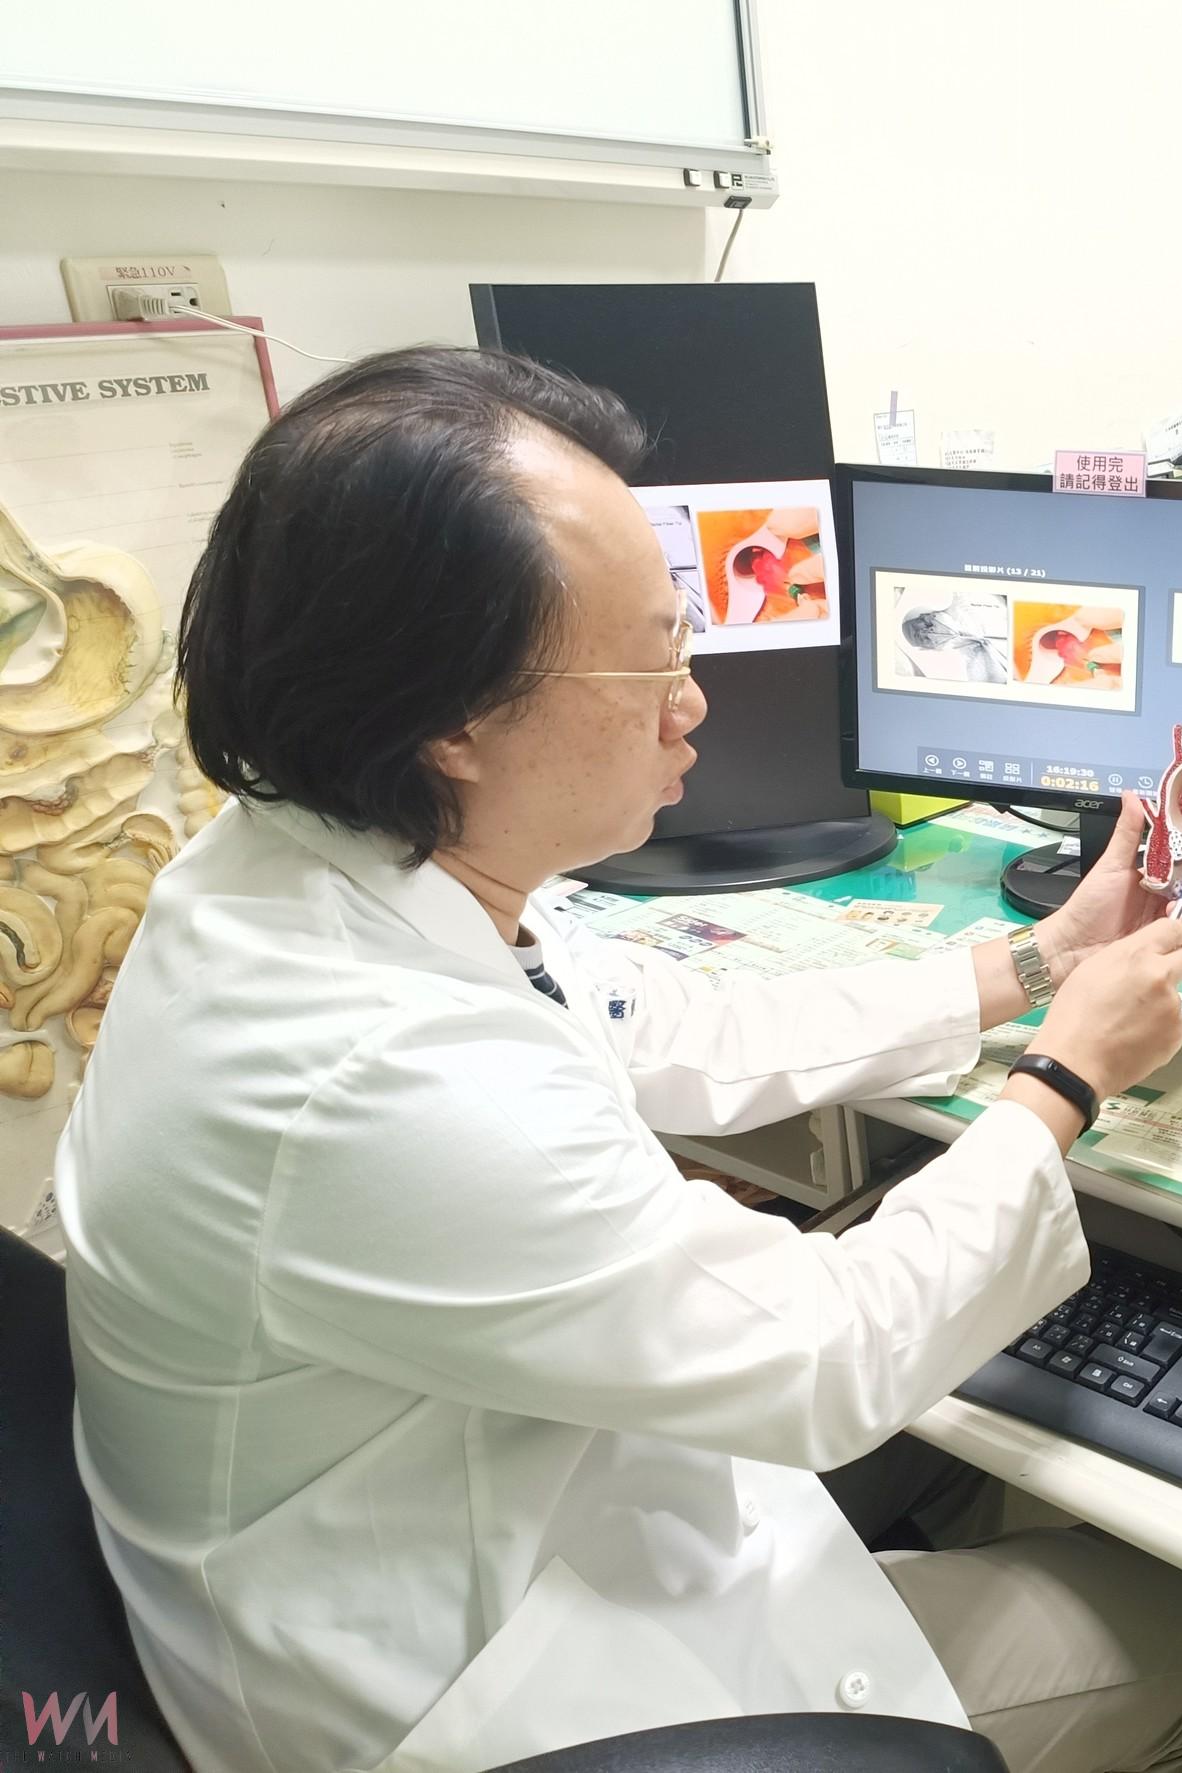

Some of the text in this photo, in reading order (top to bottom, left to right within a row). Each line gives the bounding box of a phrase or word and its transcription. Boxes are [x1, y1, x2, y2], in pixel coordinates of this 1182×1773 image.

[0, 373, 210, 407] STIVE SYSTEM
[1077, 455, 1124, 473] 使用完
[1060, 473, 1139, 492] 請記得登出
[1040, 775, 1100, 792] 0:02:16
[1074, 799, 1104, 809] acer
